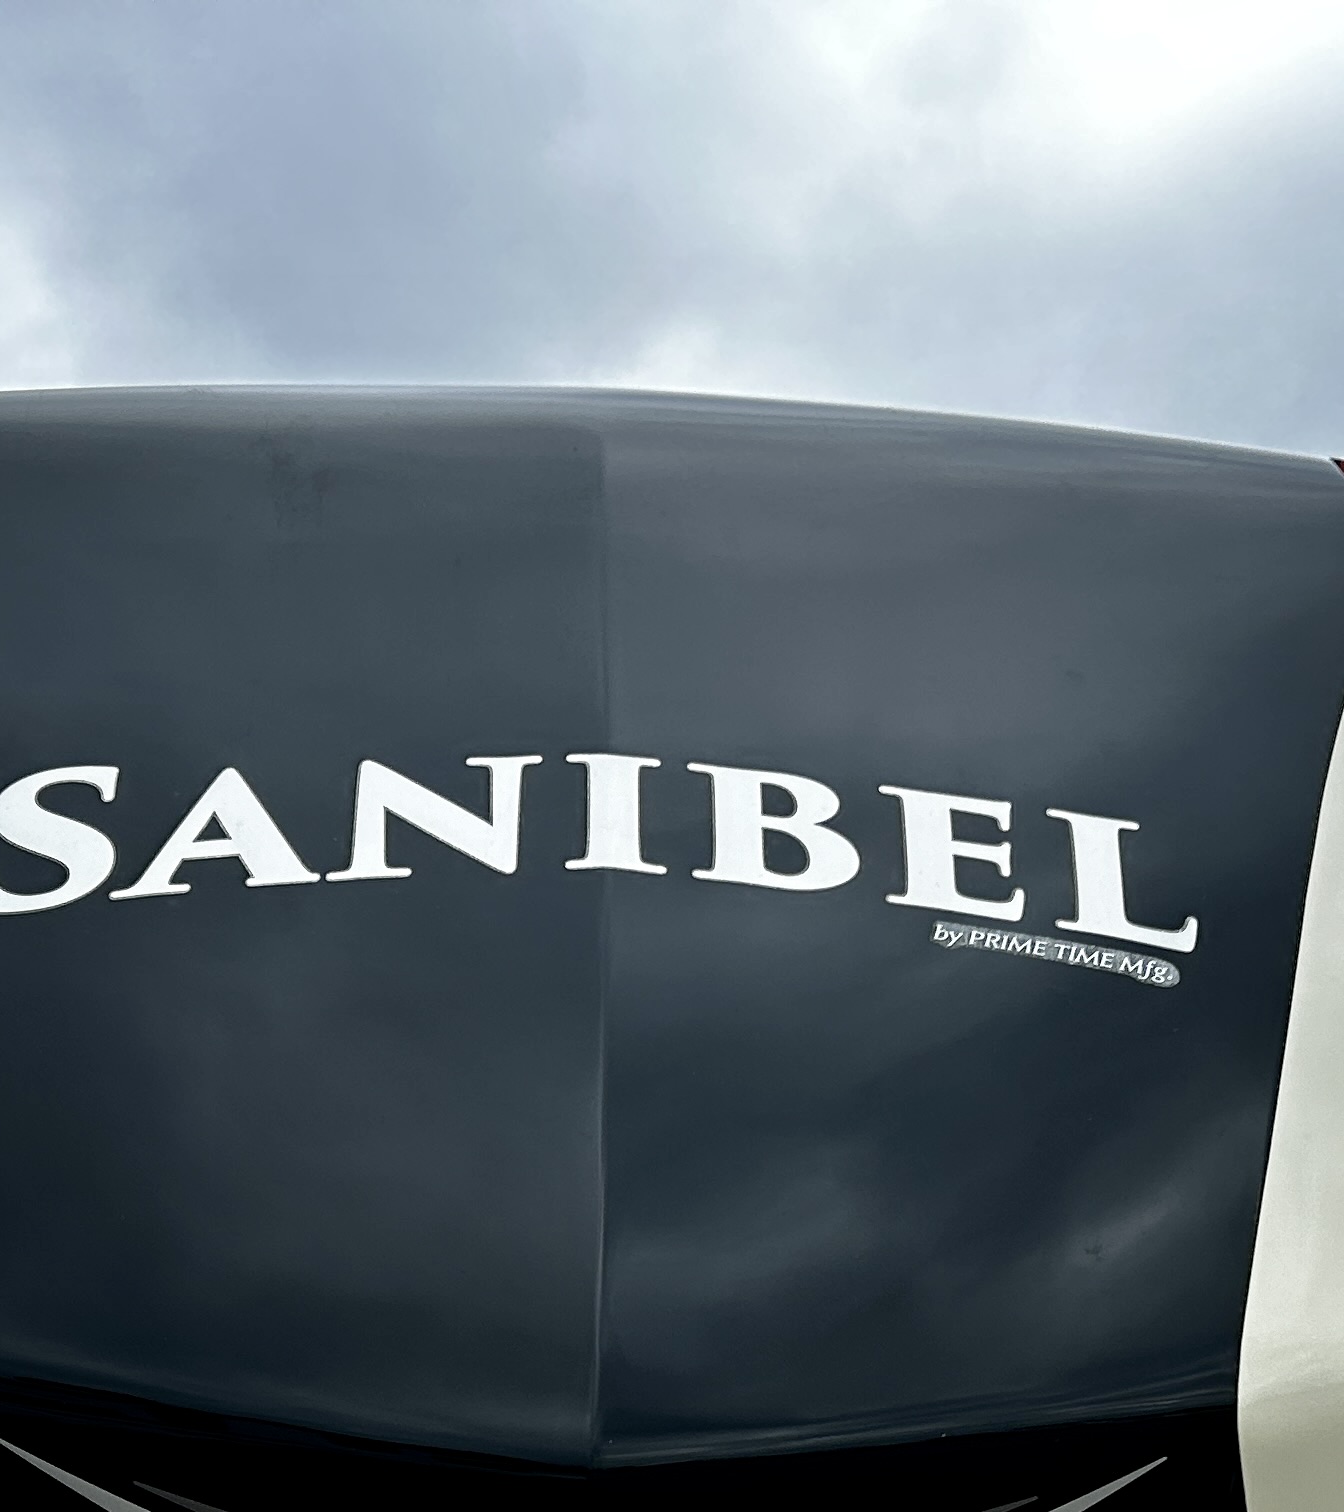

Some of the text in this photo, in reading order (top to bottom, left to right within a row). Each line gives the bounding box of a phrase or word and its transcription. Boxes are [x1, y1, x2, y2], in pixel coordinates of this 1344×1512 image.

[934, 924, 1174, 983] by PRIME TIME Mfg.
